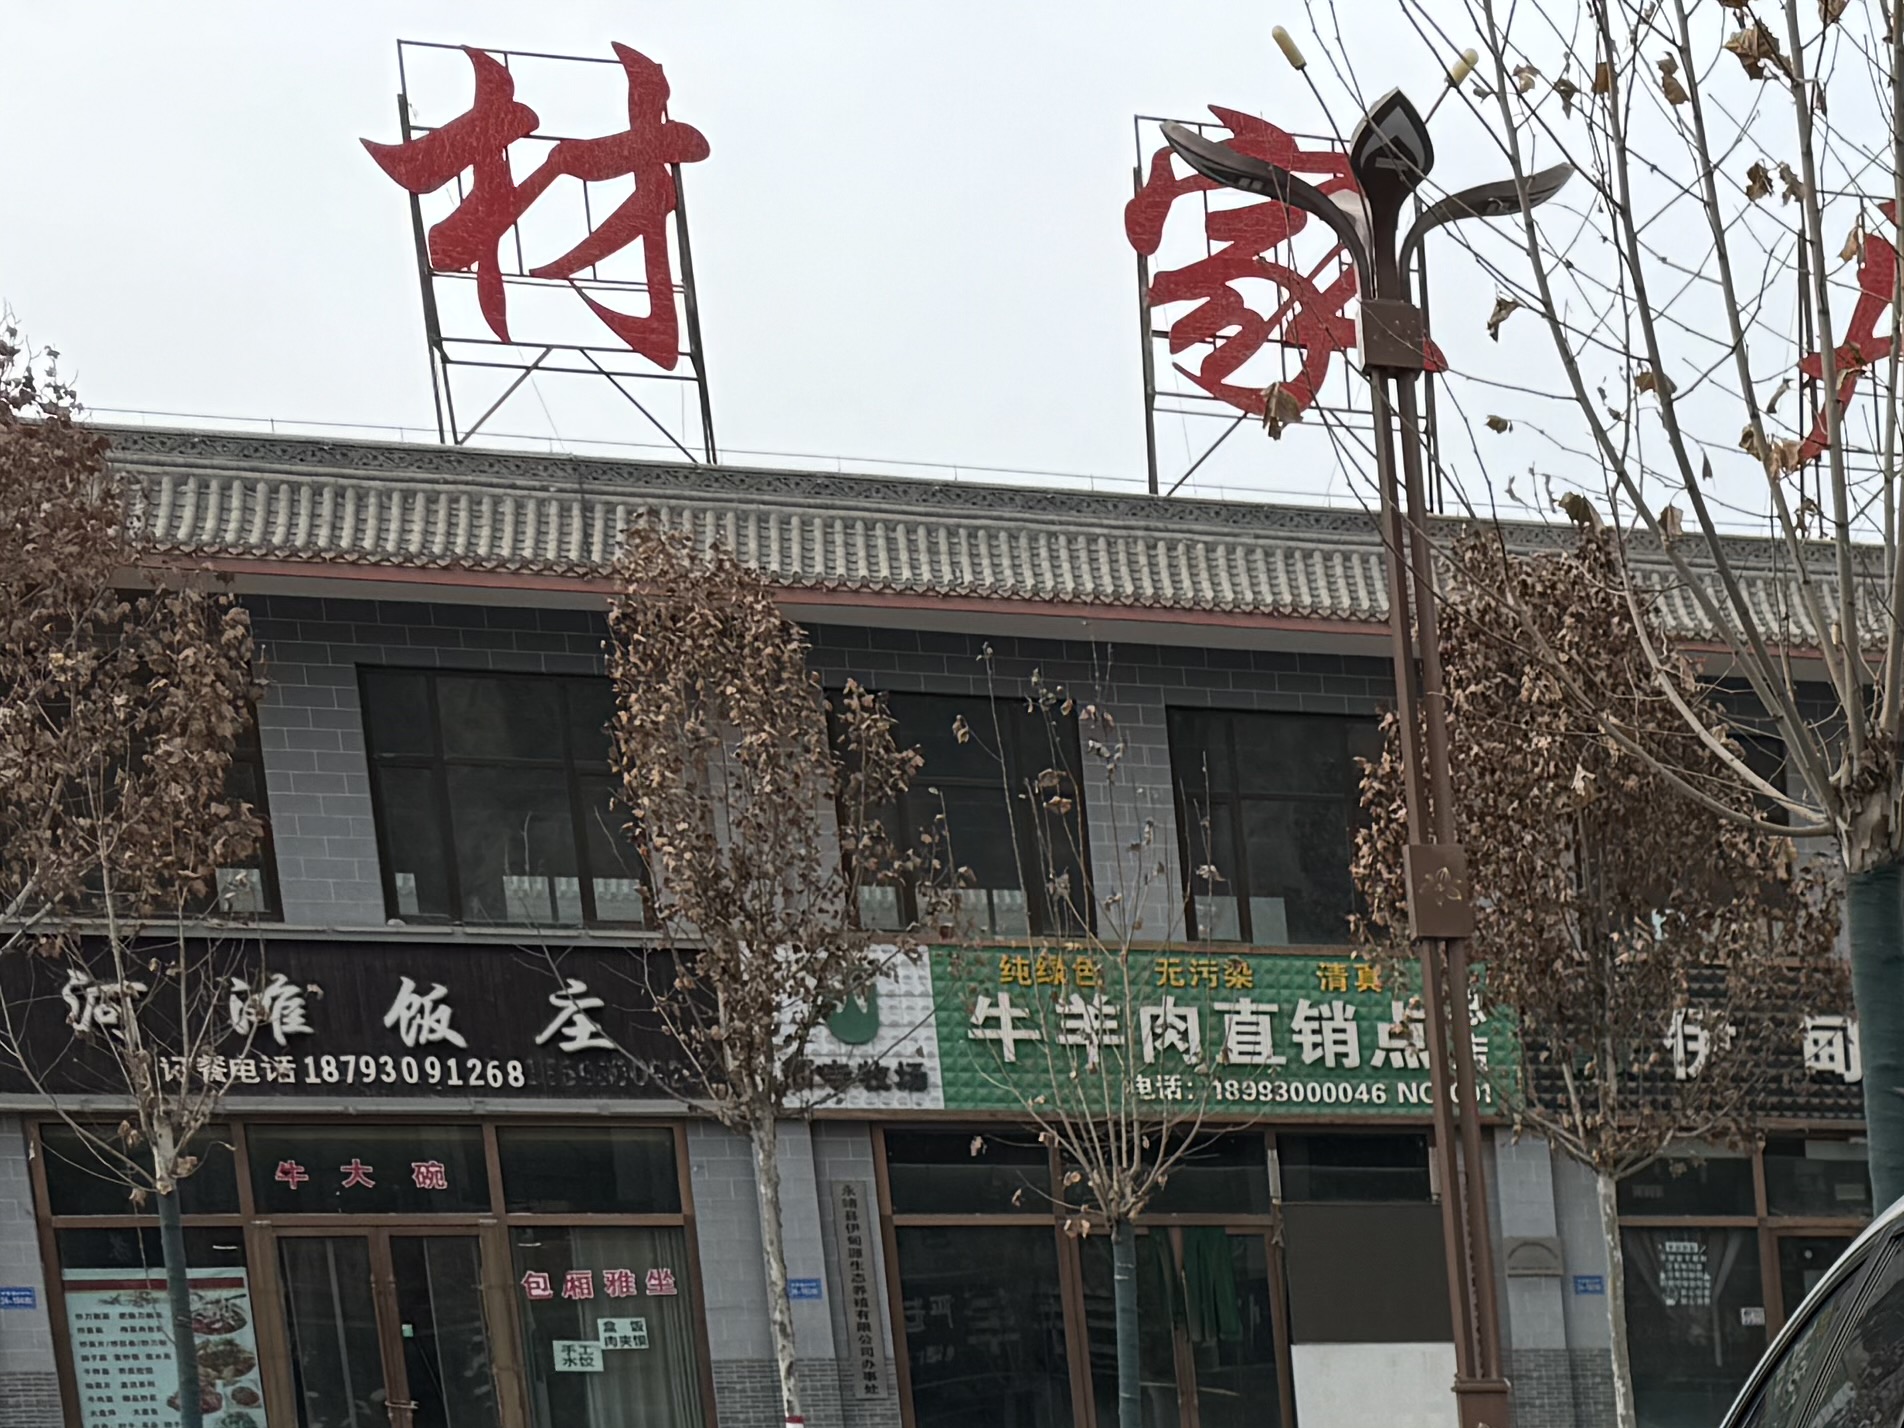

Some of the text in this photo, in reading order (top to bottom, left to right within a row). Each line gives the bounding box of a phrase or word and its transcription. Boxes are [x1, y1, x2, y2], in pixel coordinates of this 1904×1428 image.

[999, 954, 1383, 992] 纯绿色 无污染 清真
[967, 992, 1430, 1069] 牛羊肉直销点
[275, 1158, 448, 1190] 牛大碗
[521, 1268, 678, 1300] 包厢雅坐
[561, 1344, 594, 1357] 手工
[562, 1357, 595, 1368] 水饺
